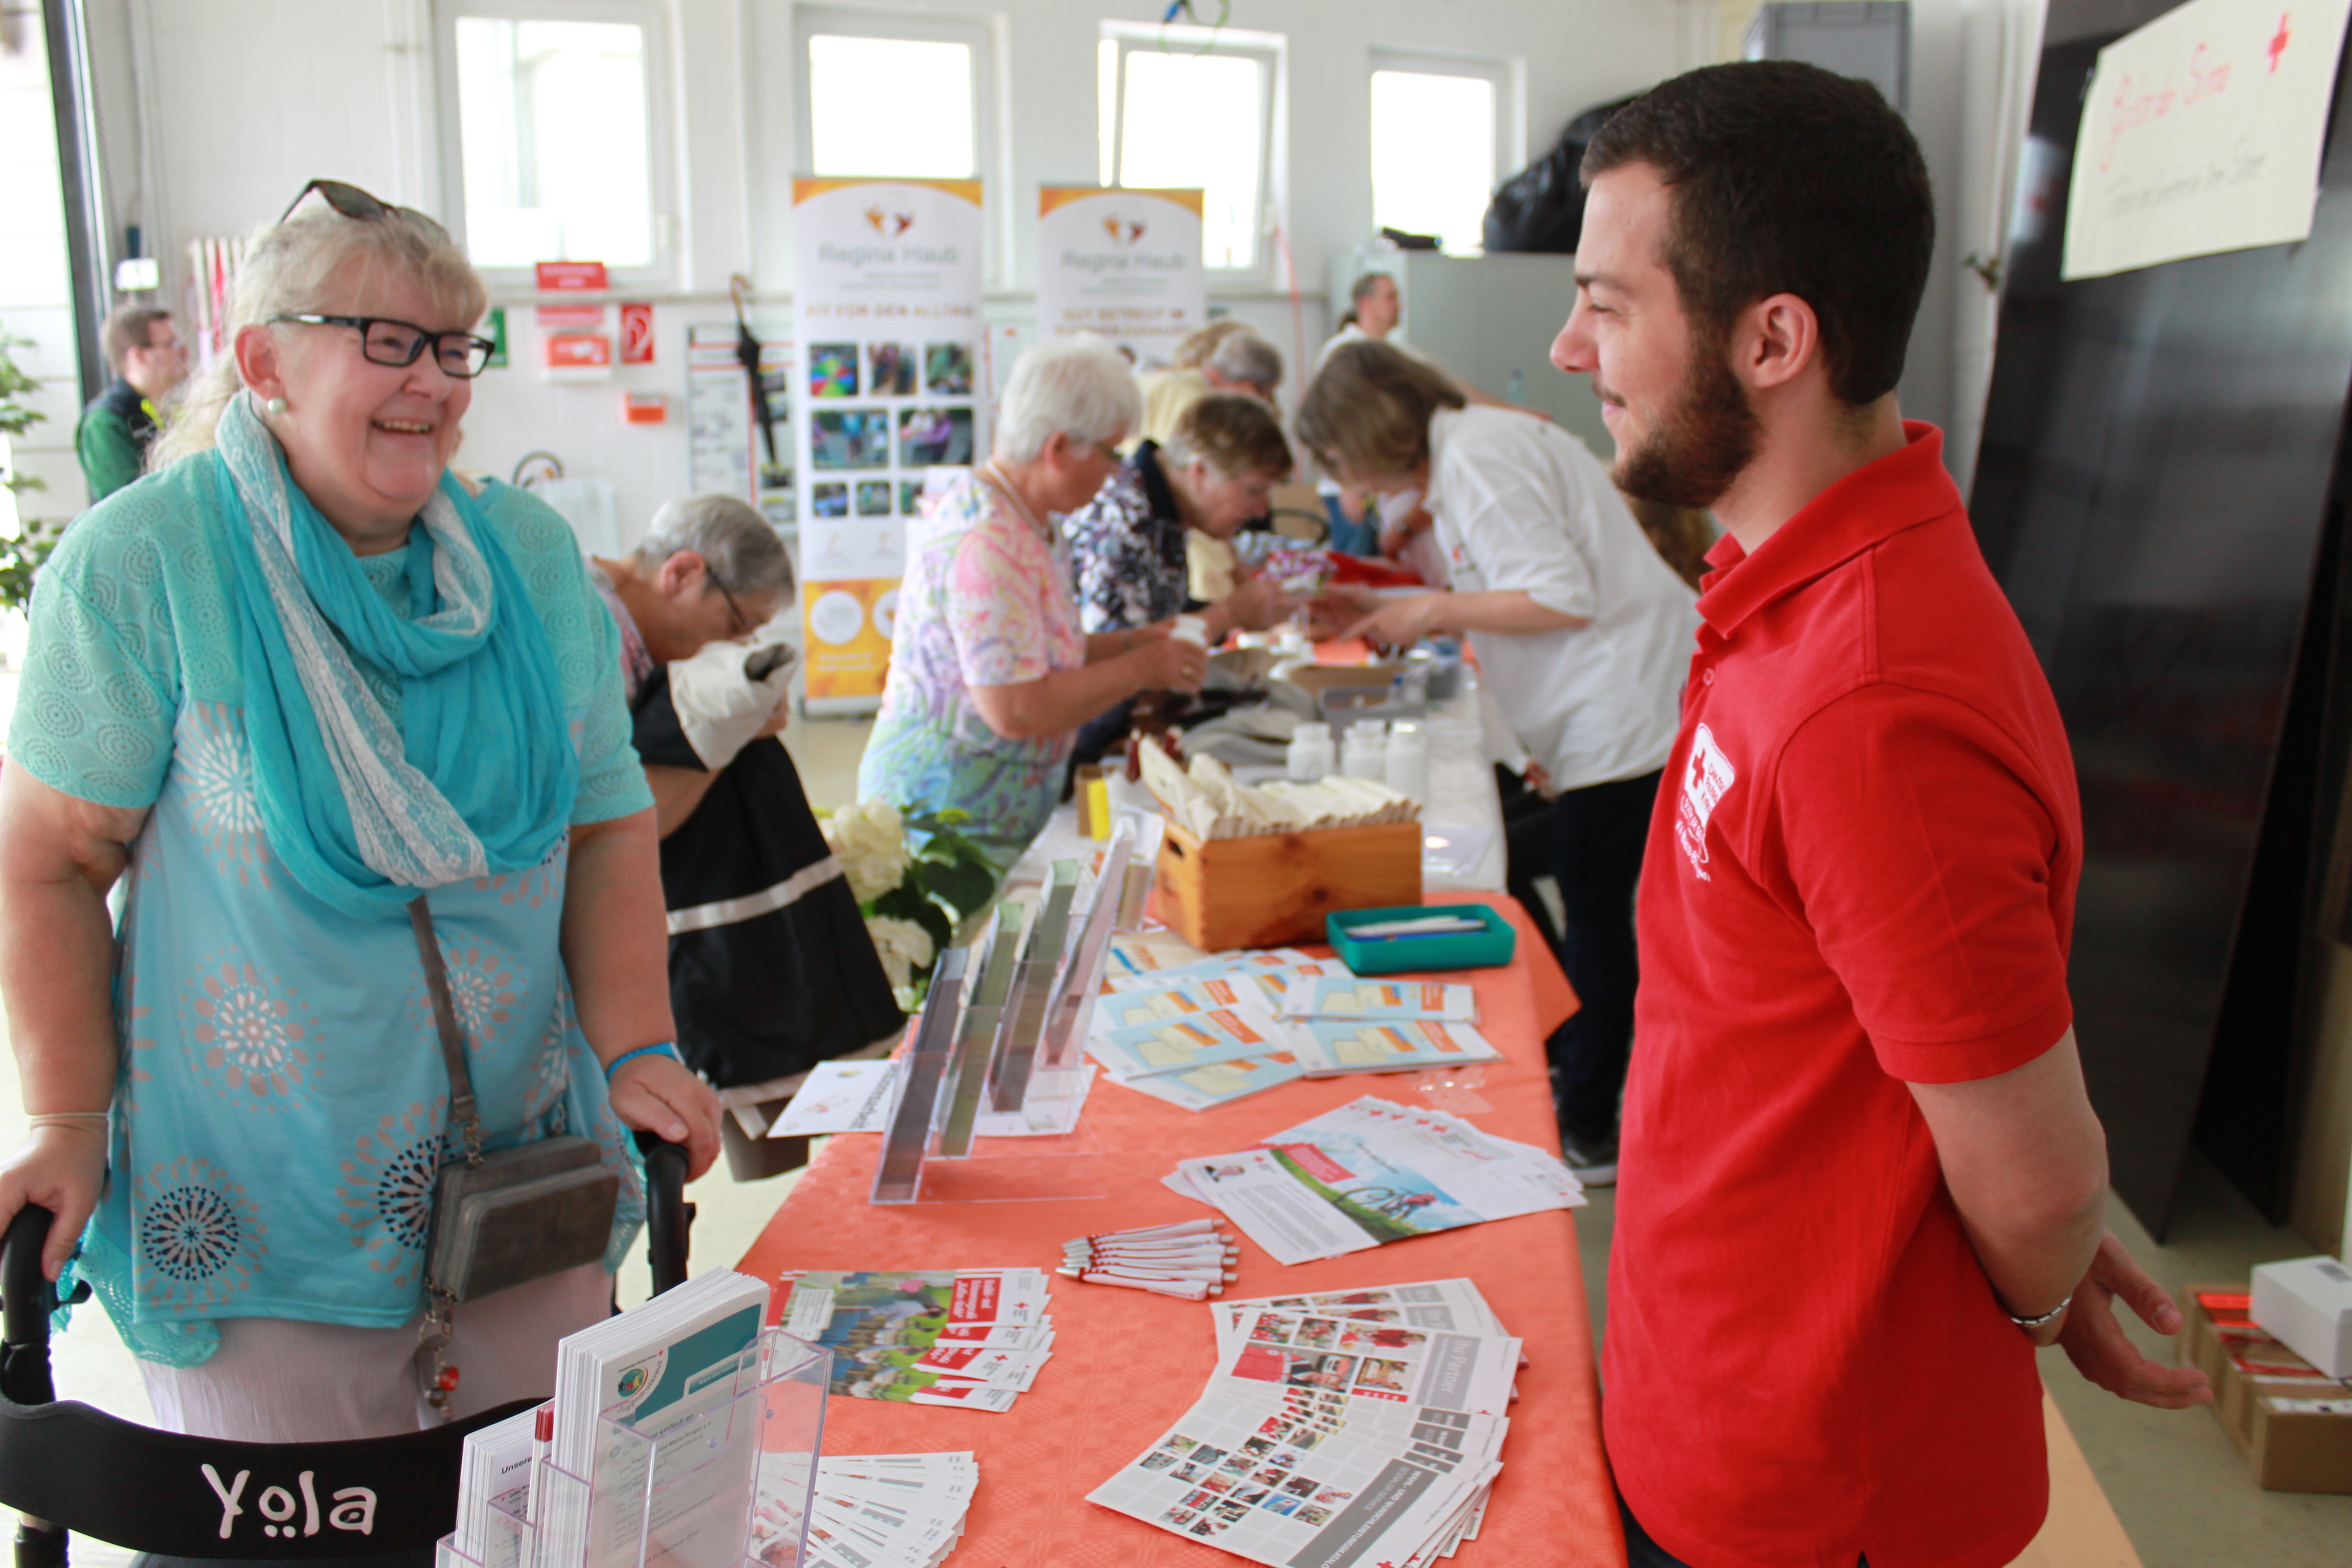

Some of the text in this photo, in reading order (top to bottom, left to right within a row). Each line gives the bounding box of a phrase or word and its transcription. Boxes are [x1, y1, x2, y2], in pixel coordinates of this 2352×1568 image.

[1453, 1339, 1471, 1355] Ihr
[1441, 1356, 1468, 1394] Partner
[659, 1419, 684, 1435] einfach
[685, 1414, 694, 1422] an
[669, 1426, 703, 1446] Mainz-Bingen
[501, 1456, 532, 1474] Unsere
[1362, 1466, 1410, 1512] SOZIALER SERVICE
[1404, 1470, 1422, 1489] WAHL-
[1393, 1488, 1407, 1502] UND
[660, 1538, 686, 1555] Deinem
